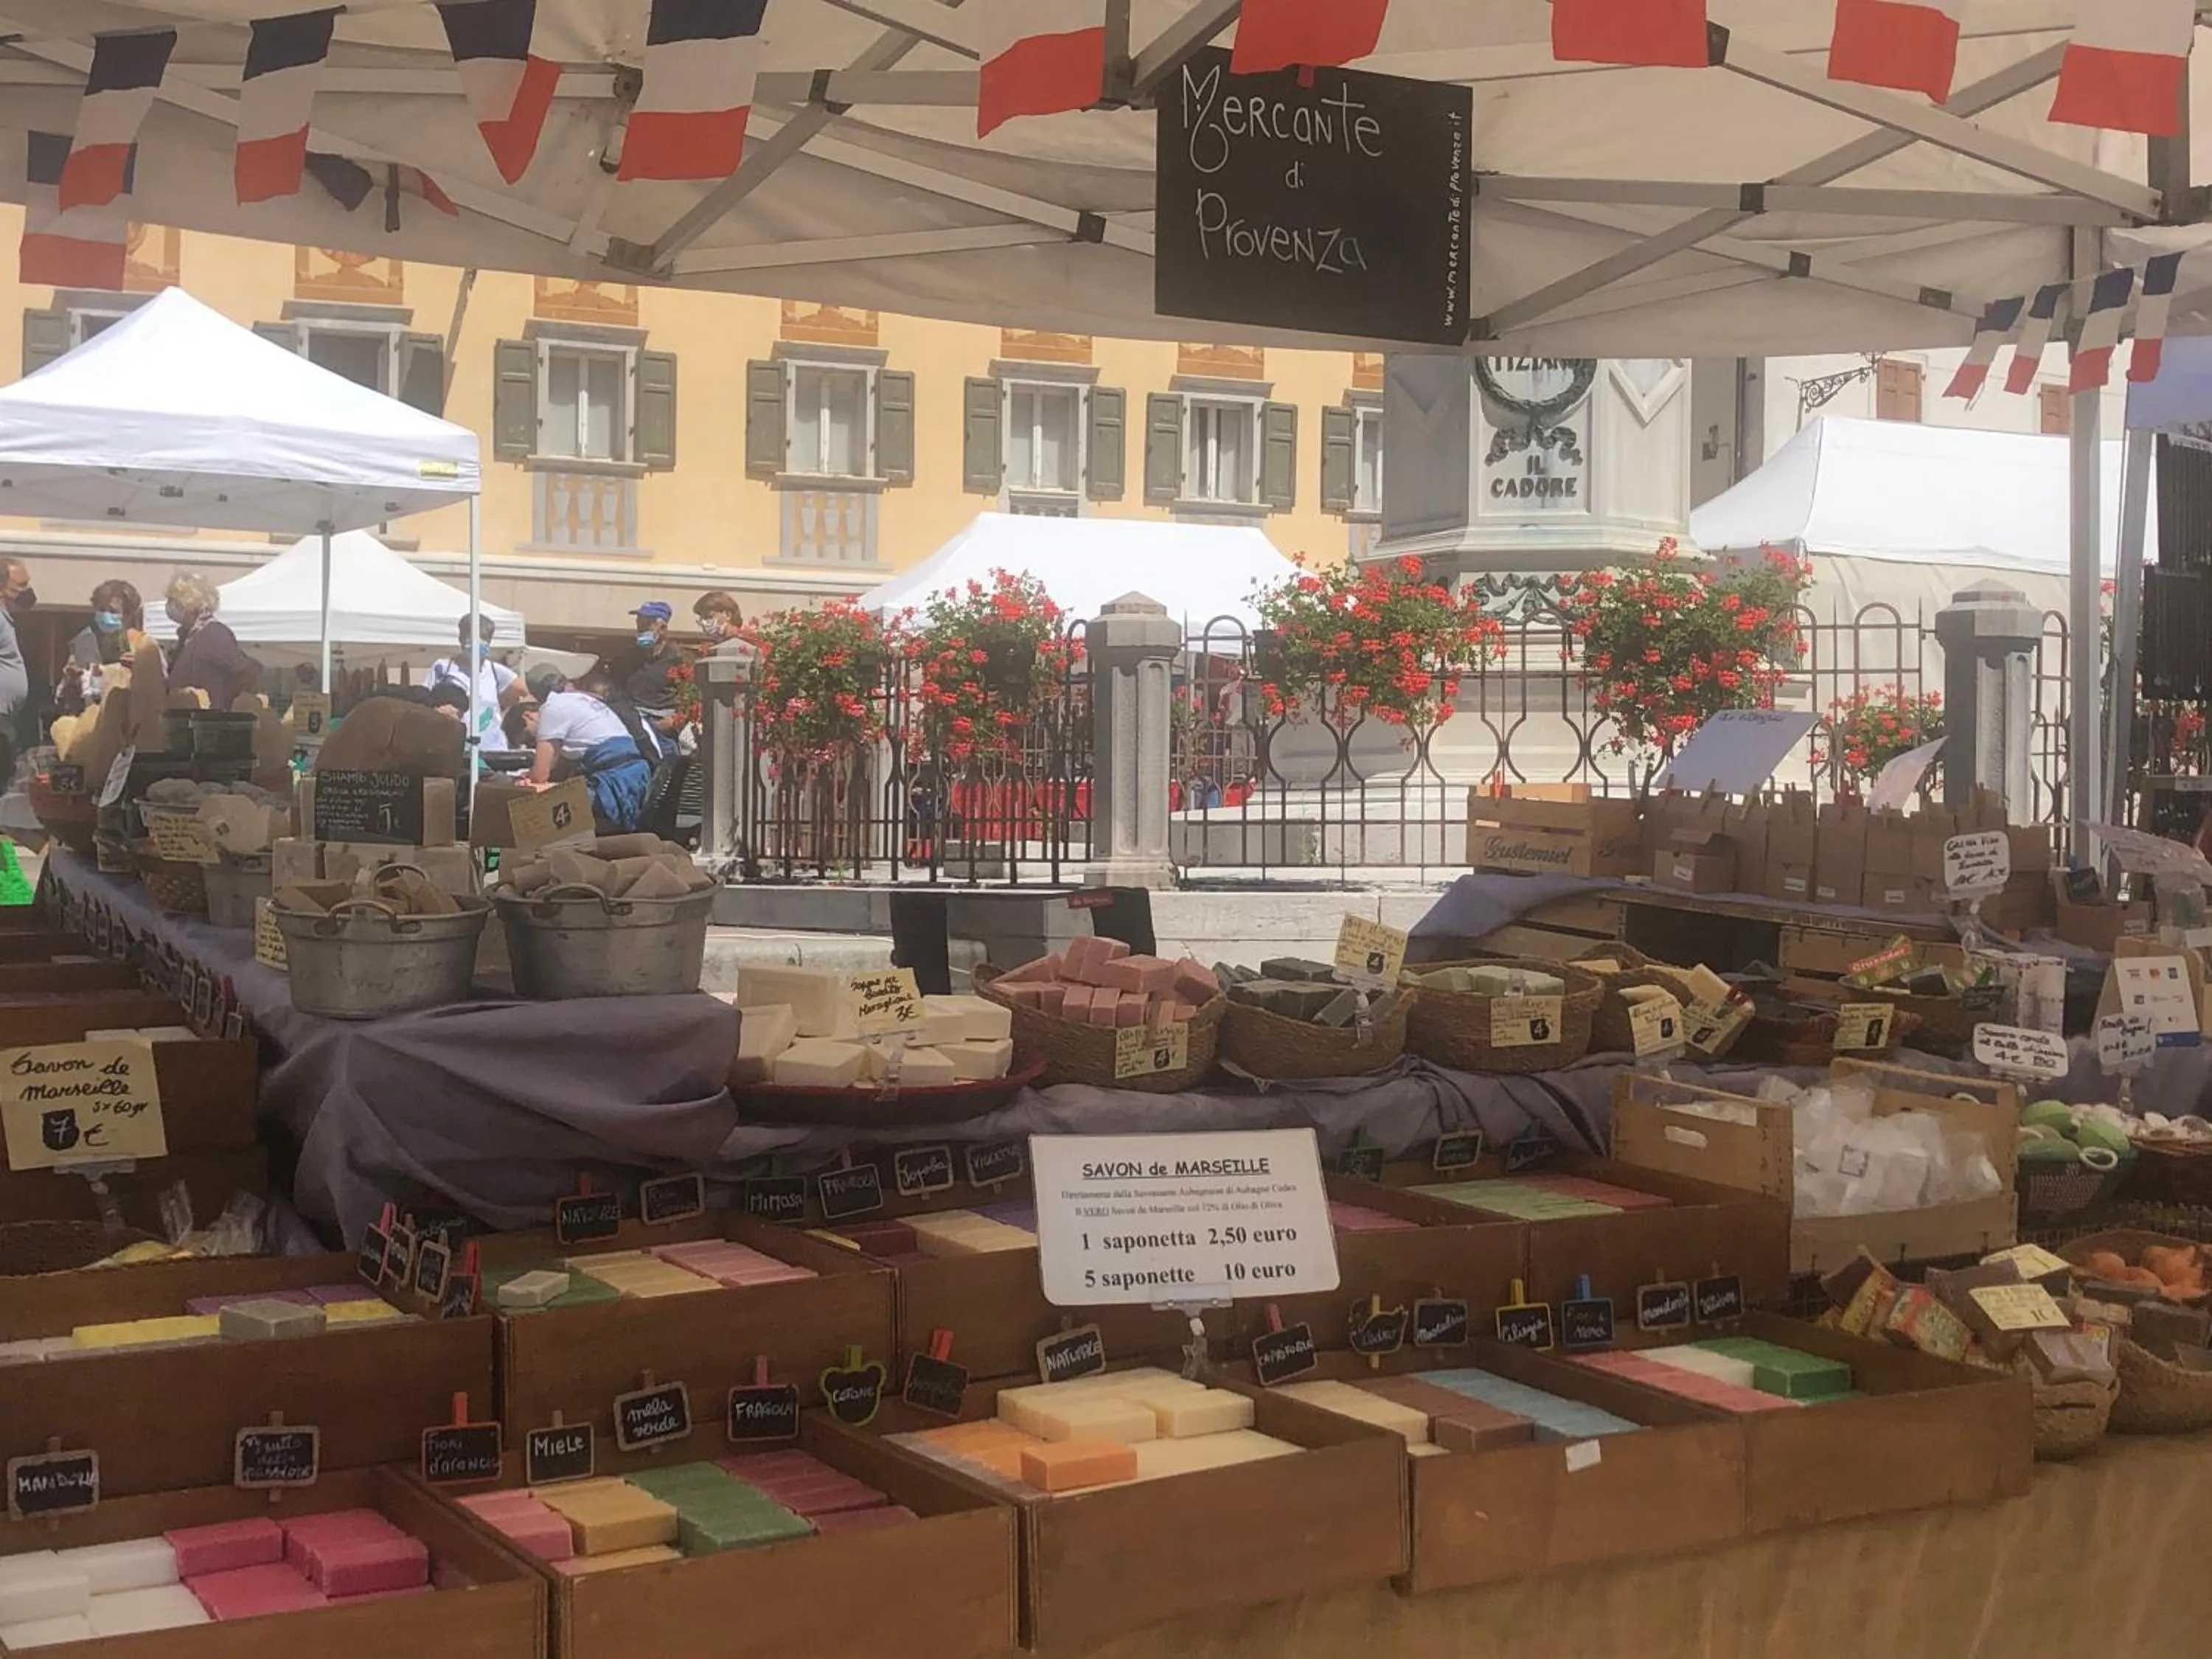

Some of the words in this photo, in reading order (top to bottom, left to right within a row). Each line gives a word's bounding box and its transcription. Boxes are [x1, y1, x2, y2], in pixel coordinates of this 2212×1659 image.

[1285, 161, 1304, 189] di
[1526, 456, 1545, 476] IL
[1490, 477, 1577, 498] CADORE
[10, 1051, 95, 1076] Savon
[99, 1056, 131, 1076] de
[50, 1116, 72, 1144] 7
[1082, 1162, 1142, 1178] SAVON
[1149, 1161, 1168, 1177] de
[1175, 1157, 1270, 1176] MARSEILLE
[1082, 1233, 1091, 1251] 1
[1102, 1229, 1196, 1253] saponetta
[1207, 1226, 1247, 1247] 2,50
[1253, 1227, 1298, 1243] euro
[1084, 1270, 1096, 1288] 5
[1101, 1266, 1195, 1290] saponette
[1224, 1263, 1245, 1281] 10
[1251, 1262, 1296, 1279] euro
